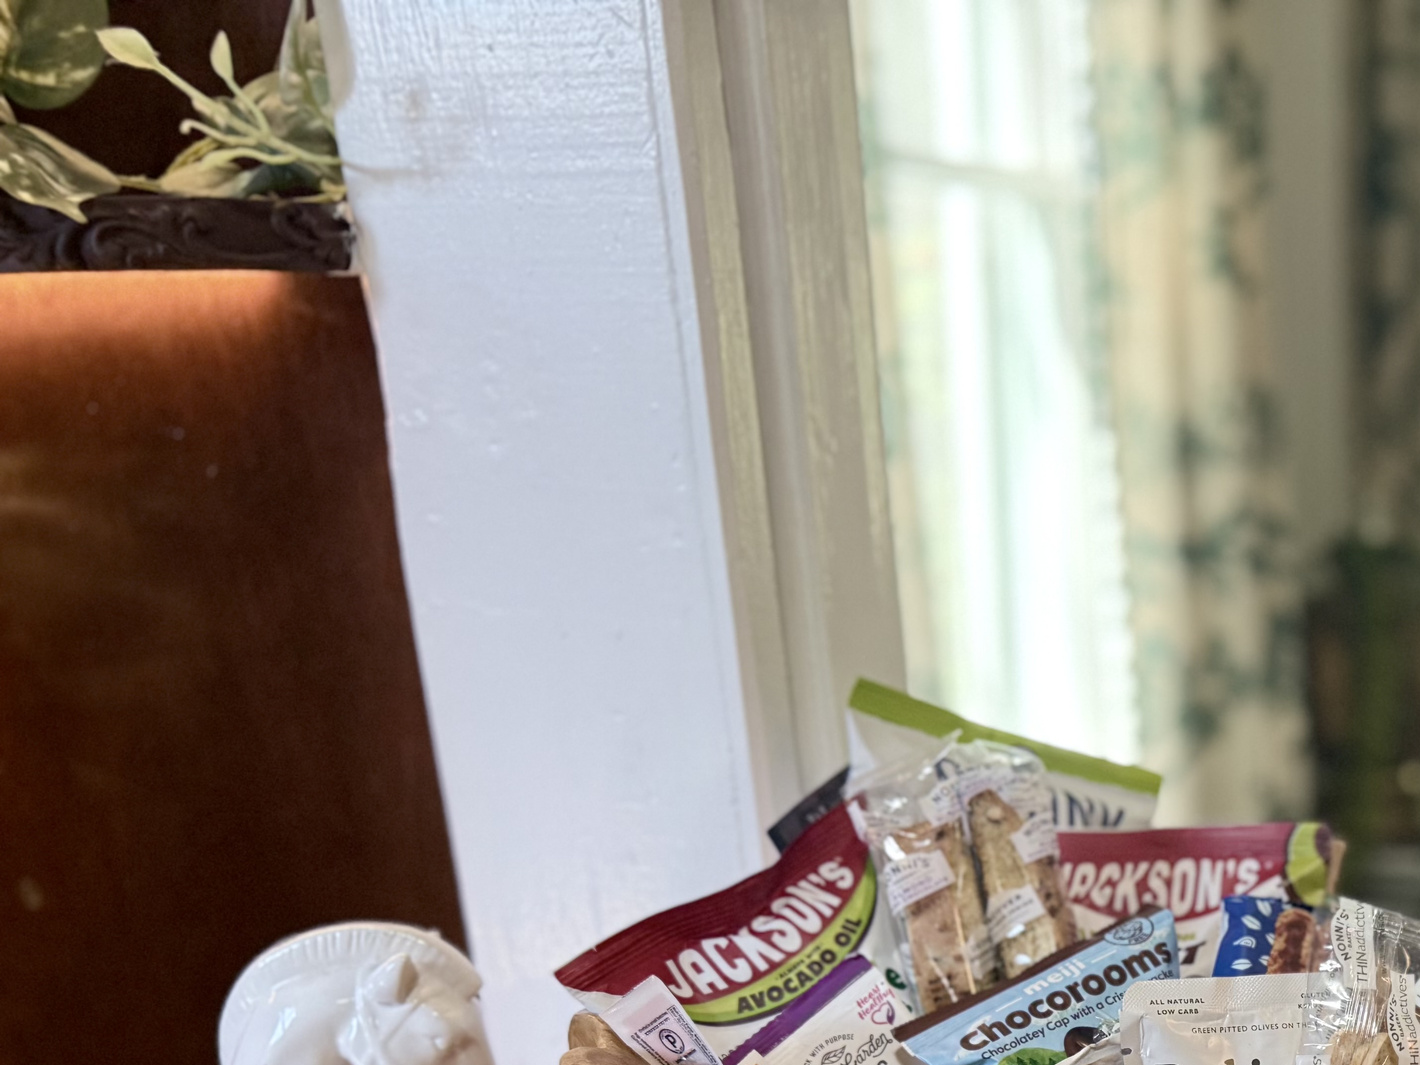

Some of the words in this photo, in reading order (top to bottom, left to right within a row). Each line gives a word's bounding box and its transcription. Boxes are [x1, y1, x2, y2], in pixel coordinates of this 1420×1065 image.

[667, 860, 854, 1000] JACKSON'S
[1334, 910, 1352, 961] NONNI'S
[738, 949, 837, 1014] AVOCADO
[834, 918, 862, 947] OIL
[1023, 958, 1087, 996] meiji
[1167, 998, 1205, 1006] NATURAL
[1177, 1008, 1199, 1016] CARB
[810, 1044, 825, 1058] WITH
[824, 1033, 855, 1047] PURPOSE
[981, 1026, 1046, 1061] Chocolatey
[1046, 1015, 1070, 1032] Cap
[1070, 1005, 1096, 1024] with
[1097, 1001, 1105, 1011] a
[1191, 1027, 1217, 1035] GREEN
[1219, 1025, 1248, 1034] PITTED
[1251, 1023, 1279, 1032] OLIVES
[1389, 997, 1405, 1052] NONNI'S
